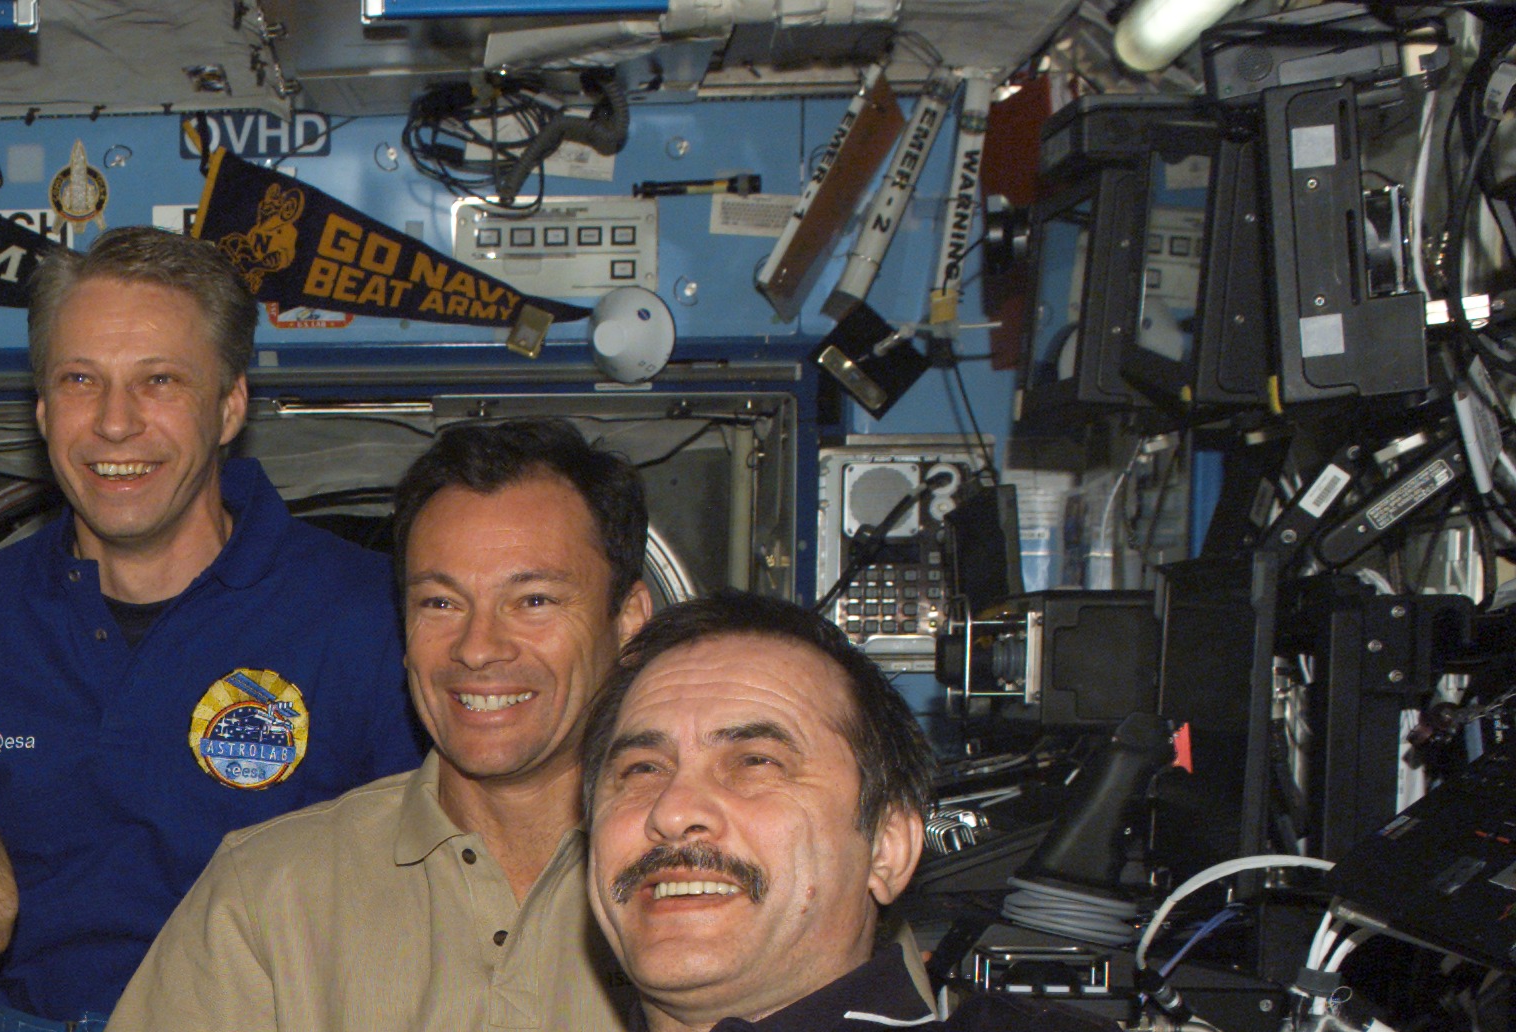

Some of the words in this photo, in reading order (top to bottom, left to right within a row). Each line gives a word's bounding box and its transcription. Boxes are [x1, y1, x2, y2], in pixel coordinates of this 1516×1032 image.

[184, 113, 328, 155] OVHD
[891, 107, 938, 190] EMER
[945, 149, 982, 281] WARNING
[253, 233, 272, 256] N
[316, 213, 402, 276] GO
[410, 254, 520, 308] NAVY
[302, 257, 412, 308] BEAT
[418, 289, 518, 321] ARMY
[5, 736, 35, 749] esa
[206, 740, 289, 761] ASTROLAB
